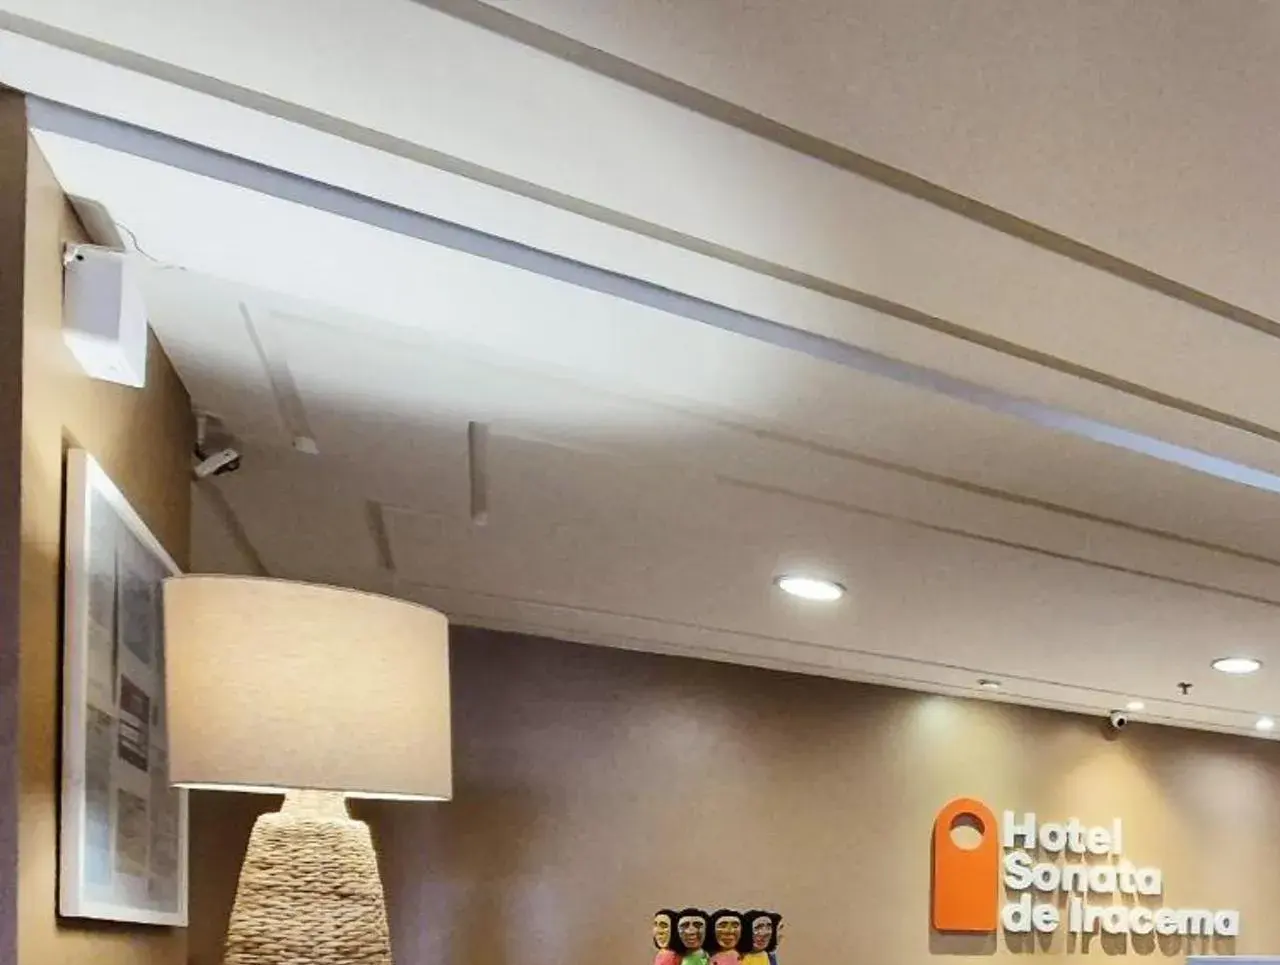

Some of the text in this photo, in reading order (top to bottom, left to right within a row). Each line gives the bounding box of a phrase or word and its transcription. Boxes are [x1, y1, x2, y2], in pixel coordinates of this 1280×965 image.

[1003, 810, 1122, 854] Hotel
[1002, 851, 1161, 894] Sonata
[1001, 893, 1239, 936] de Iracema
